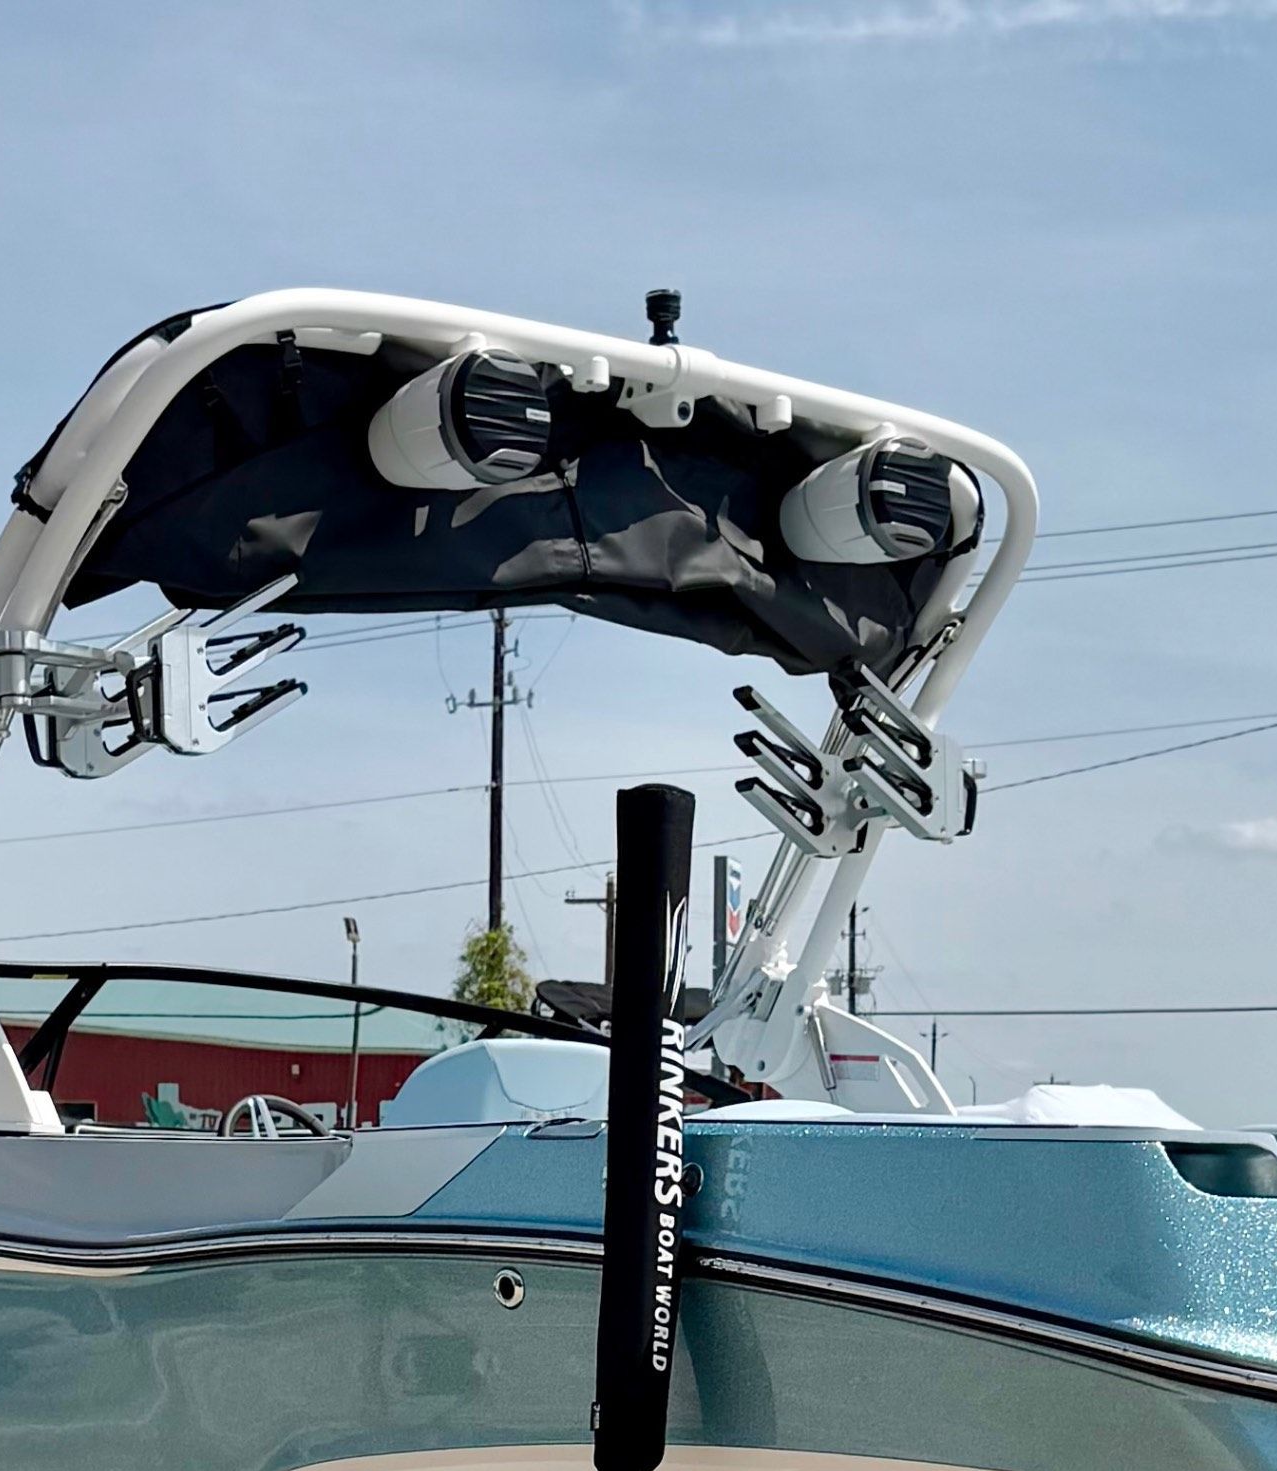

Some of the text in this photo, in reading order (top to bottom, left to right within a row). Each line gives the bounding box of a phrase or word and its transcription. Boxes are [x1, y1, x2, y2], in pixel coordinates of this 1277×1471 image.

[652, 1018, 685, 1372] RINKERS BOAT WORLD
